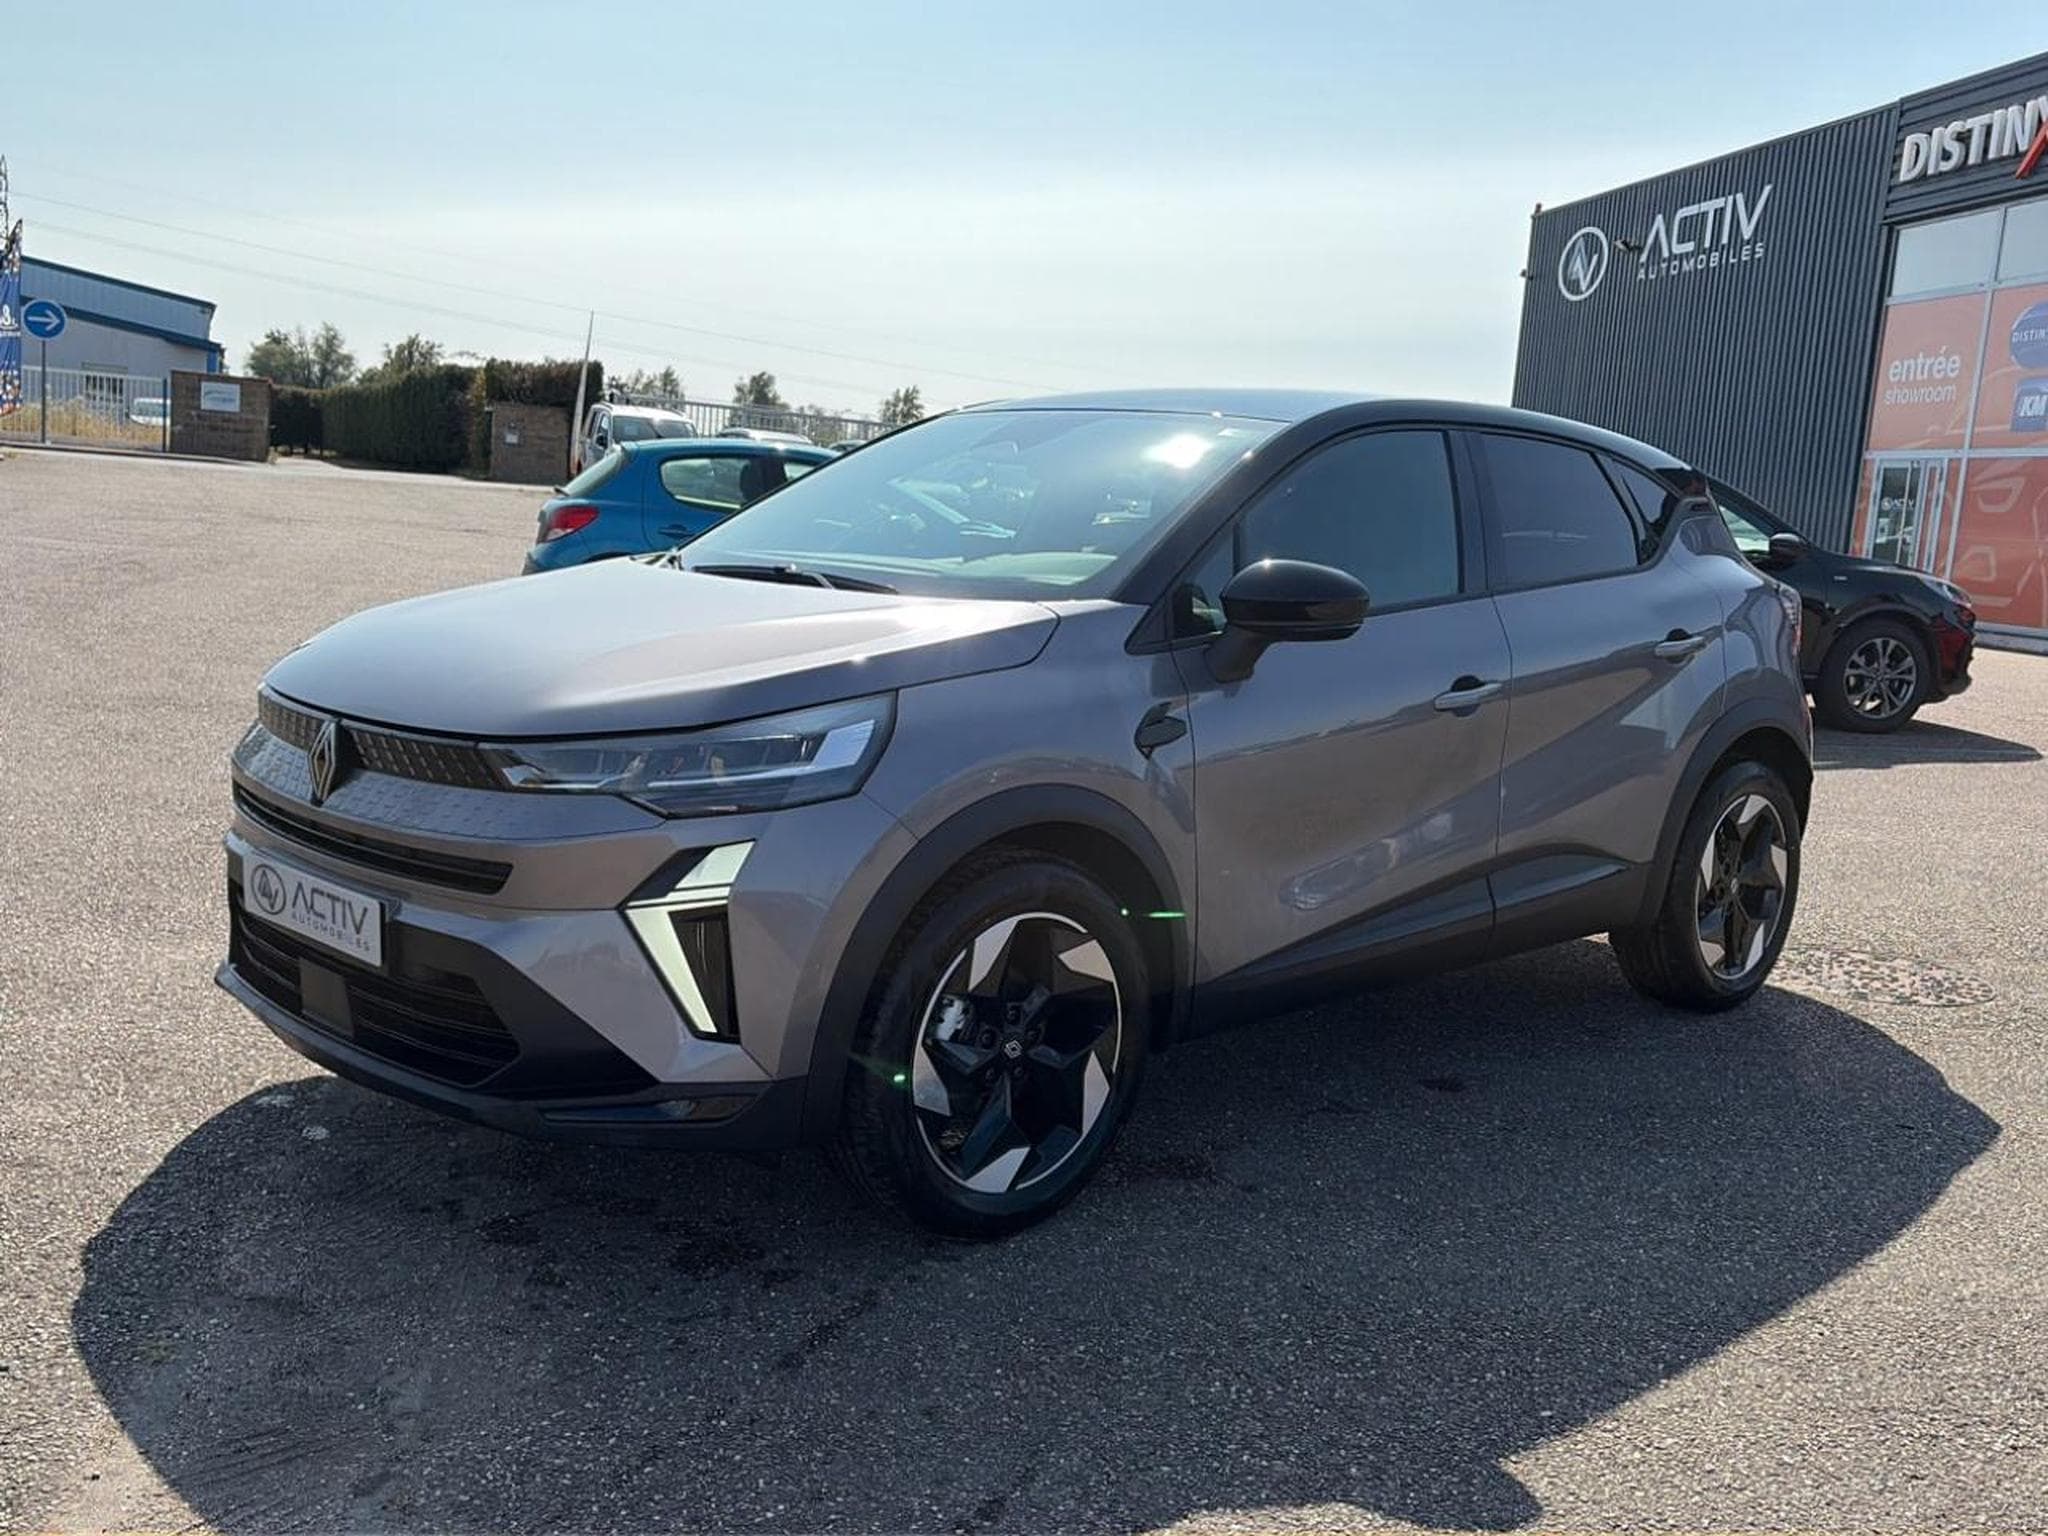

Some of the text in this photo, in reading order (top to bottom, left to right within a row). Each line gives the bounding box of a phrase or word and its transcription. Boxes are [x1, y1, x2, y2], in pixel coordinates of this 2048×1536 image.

[1639, 184, 1772, 263] ACTIV
[1637, 242, 1764, 281] AUTOMOBILES
[2012, 329, 2048, 343] DISTIN
[1888, 346, 1960, 382] entrée
[1885, 384, 1956, 405] showroom
[292, 882, 367, 934] ACTIV
[291, 911, 370, 951] AUTOMOBES
